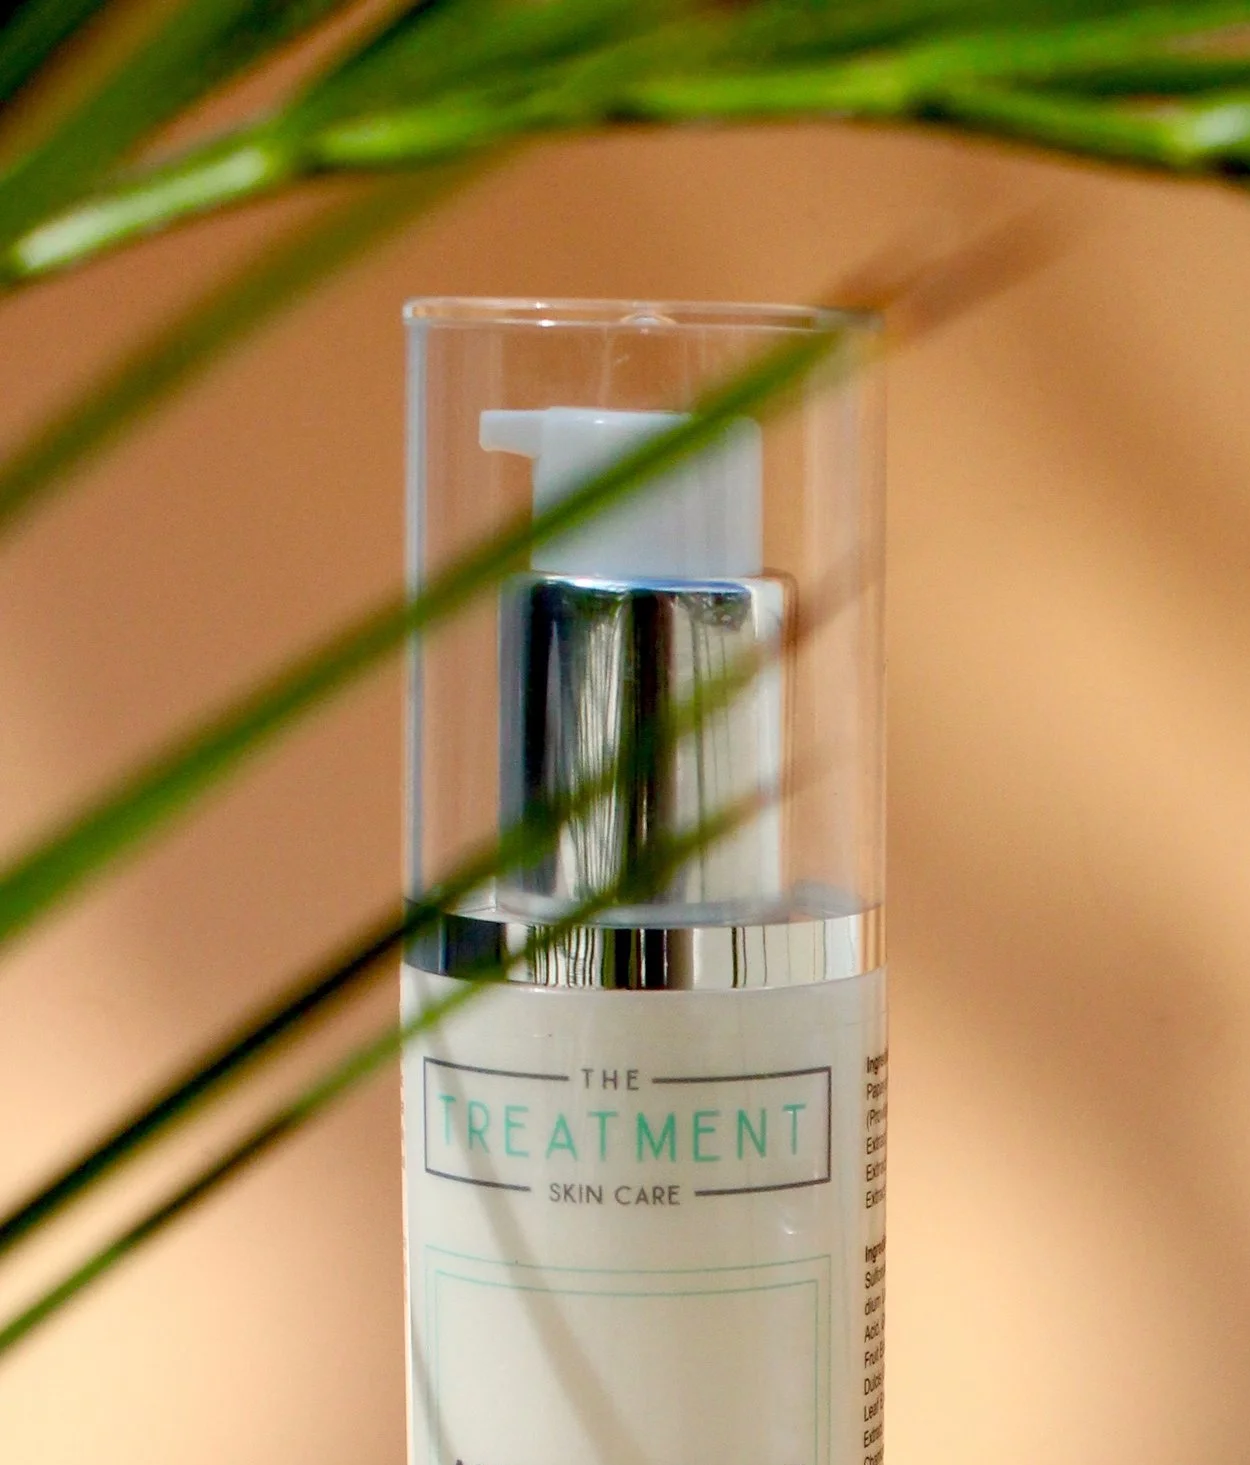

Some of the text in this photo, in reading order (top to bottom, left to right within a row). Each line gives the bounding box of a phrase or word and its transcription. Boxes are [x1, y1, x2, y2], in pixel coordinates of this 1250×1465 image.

[581, 1068, 640, 1091] THE
[439, 1095, 807, 1163] TREATMENT
[548, 1182, 681, 1206] SKIN CARE
